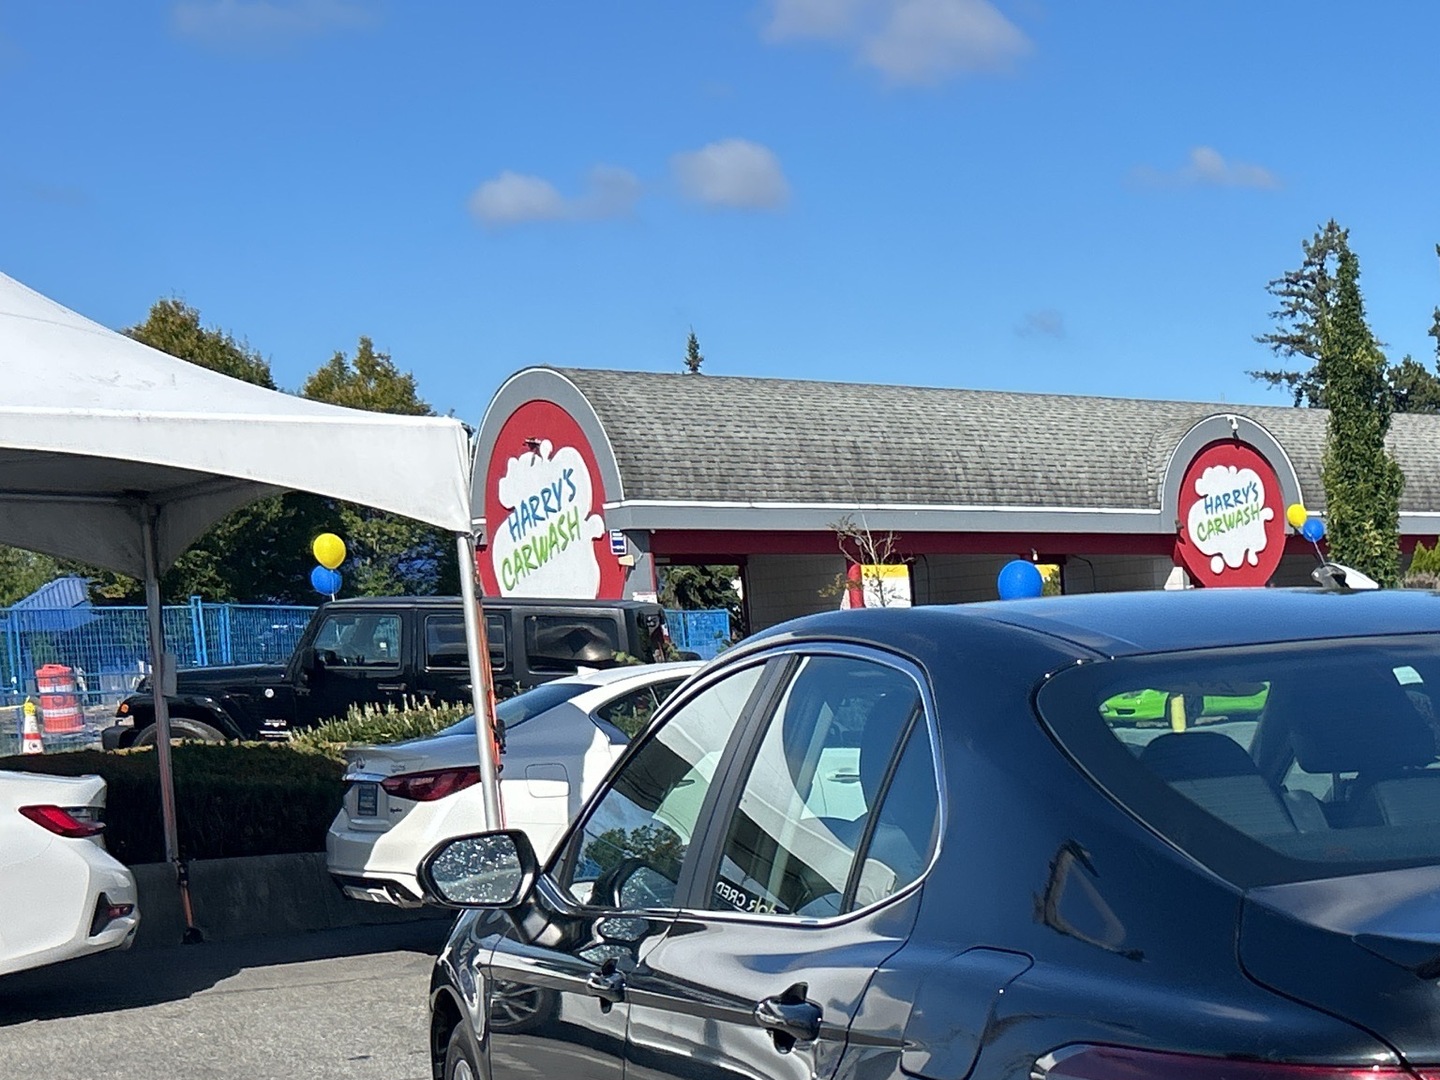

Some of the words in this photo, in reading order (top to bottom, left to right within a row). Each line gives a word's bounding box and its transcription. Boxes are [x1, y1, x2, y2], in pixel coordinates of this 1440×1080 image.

[508, 468, 577, 542] HARRY'S
[1196, 503, 1260, 542] CARWASH
[1204, 481, 1258, 515] HARRY'S
[502, 505, 582, 591] CARWASH
